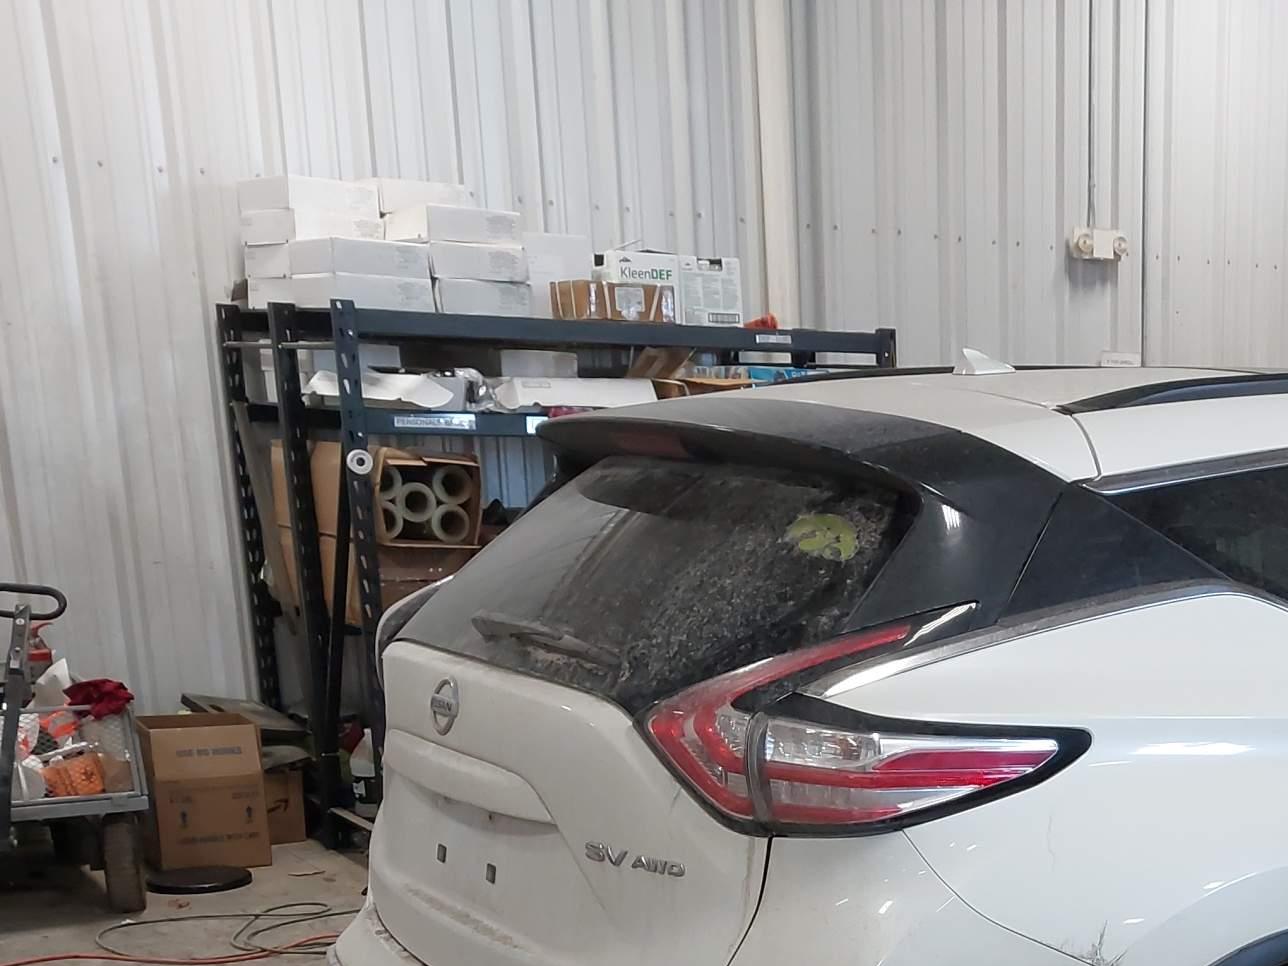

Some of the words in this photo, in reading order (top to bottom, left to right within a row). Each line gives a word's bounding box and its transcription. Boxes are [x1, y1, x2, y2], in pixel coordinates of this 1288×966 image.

[620, 266, 673, 281] KleenDEF
[585, 841, 629, 867] SV
[631, 854, 686, 877] AWD
